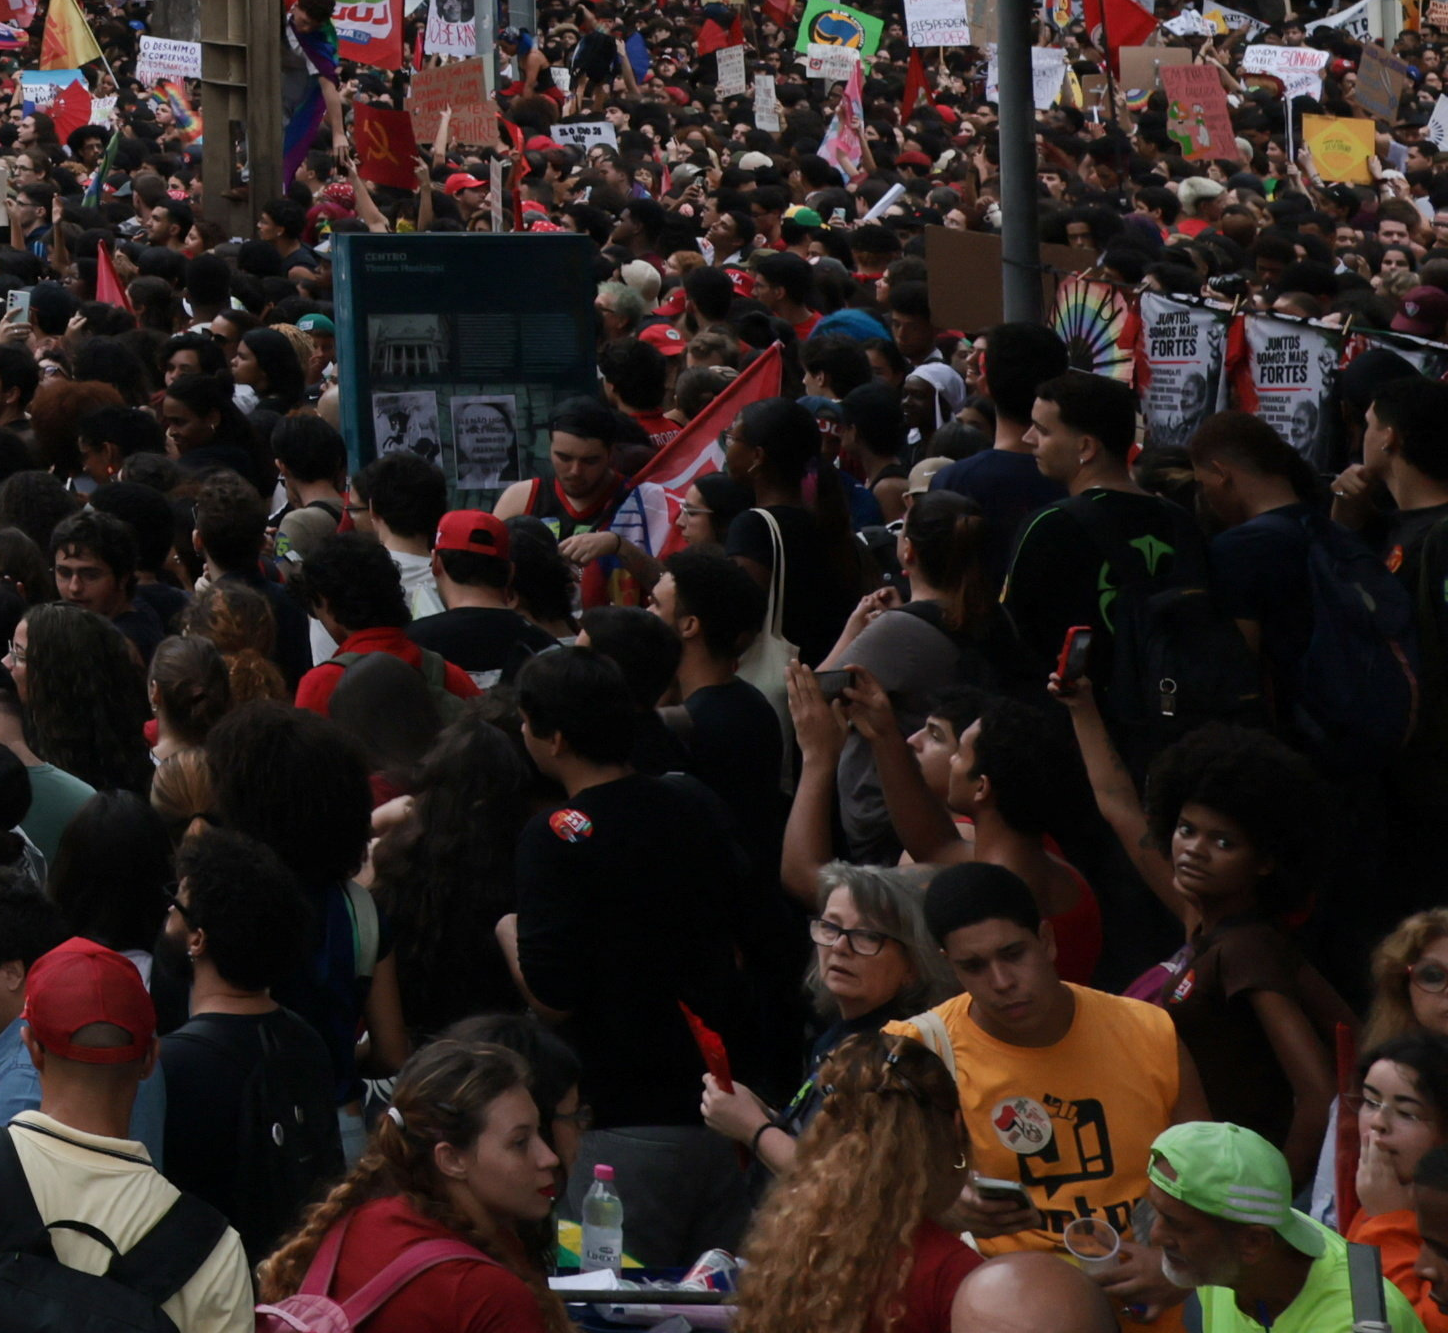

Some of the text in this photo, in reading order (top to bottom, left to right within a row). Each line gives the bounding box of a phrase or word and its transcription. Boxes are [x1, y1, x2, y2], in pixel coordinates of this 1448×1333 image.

[143, 42, 149, 51] O
[910, 32, 969, 46] O PODER
[149, 53, 199, 66] CONSERVADOR
[1277, 49, 1326, 67] SONHAR
[364, 252, 408, 262] CENTRO
[1156, 311, 1191, 326] JUNTOS
[1149, 324, 1199, 339] SOMOS MAIS
[1150, 339, 1197, 357] FORTES
[1264, 336, 1301, 351] JUNTOS
[1257, 350, 1309, 365] SOMOS MAIS
[1260, 364, 1308, 384] FORTES
